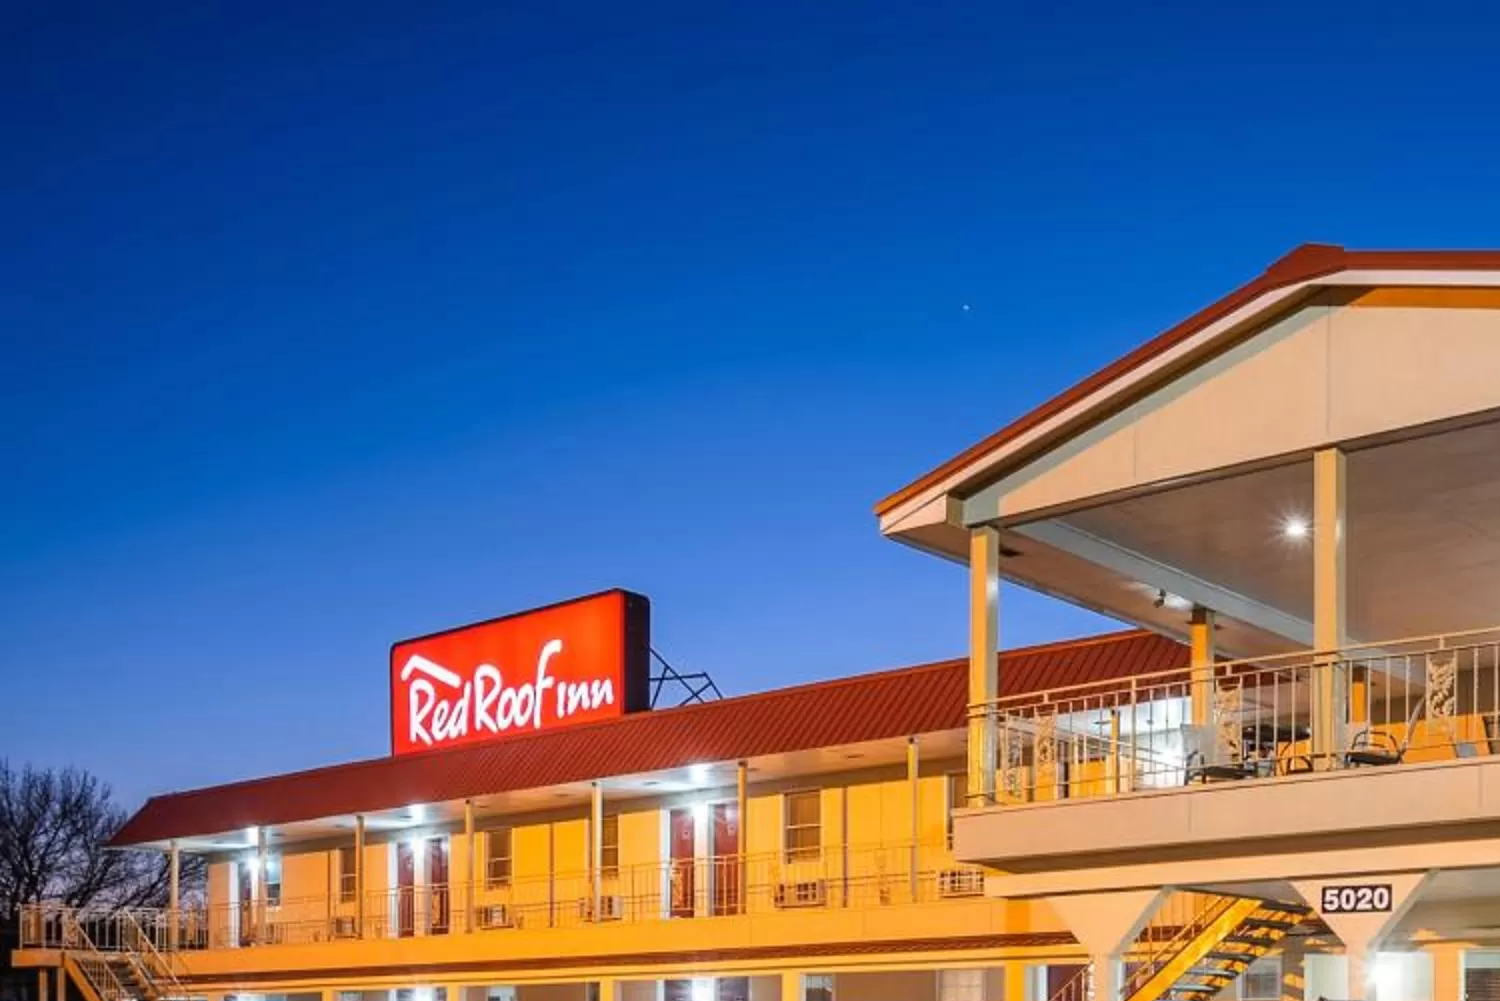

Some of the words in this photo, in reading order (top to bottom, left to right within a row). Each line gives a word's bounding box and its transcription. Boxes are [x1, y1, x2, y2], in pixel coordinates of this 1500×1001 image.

[409, 678, 471, 746] Red
[473, 639, 563, 734] Roof
[1323, 887, 1389, 911] 5020
